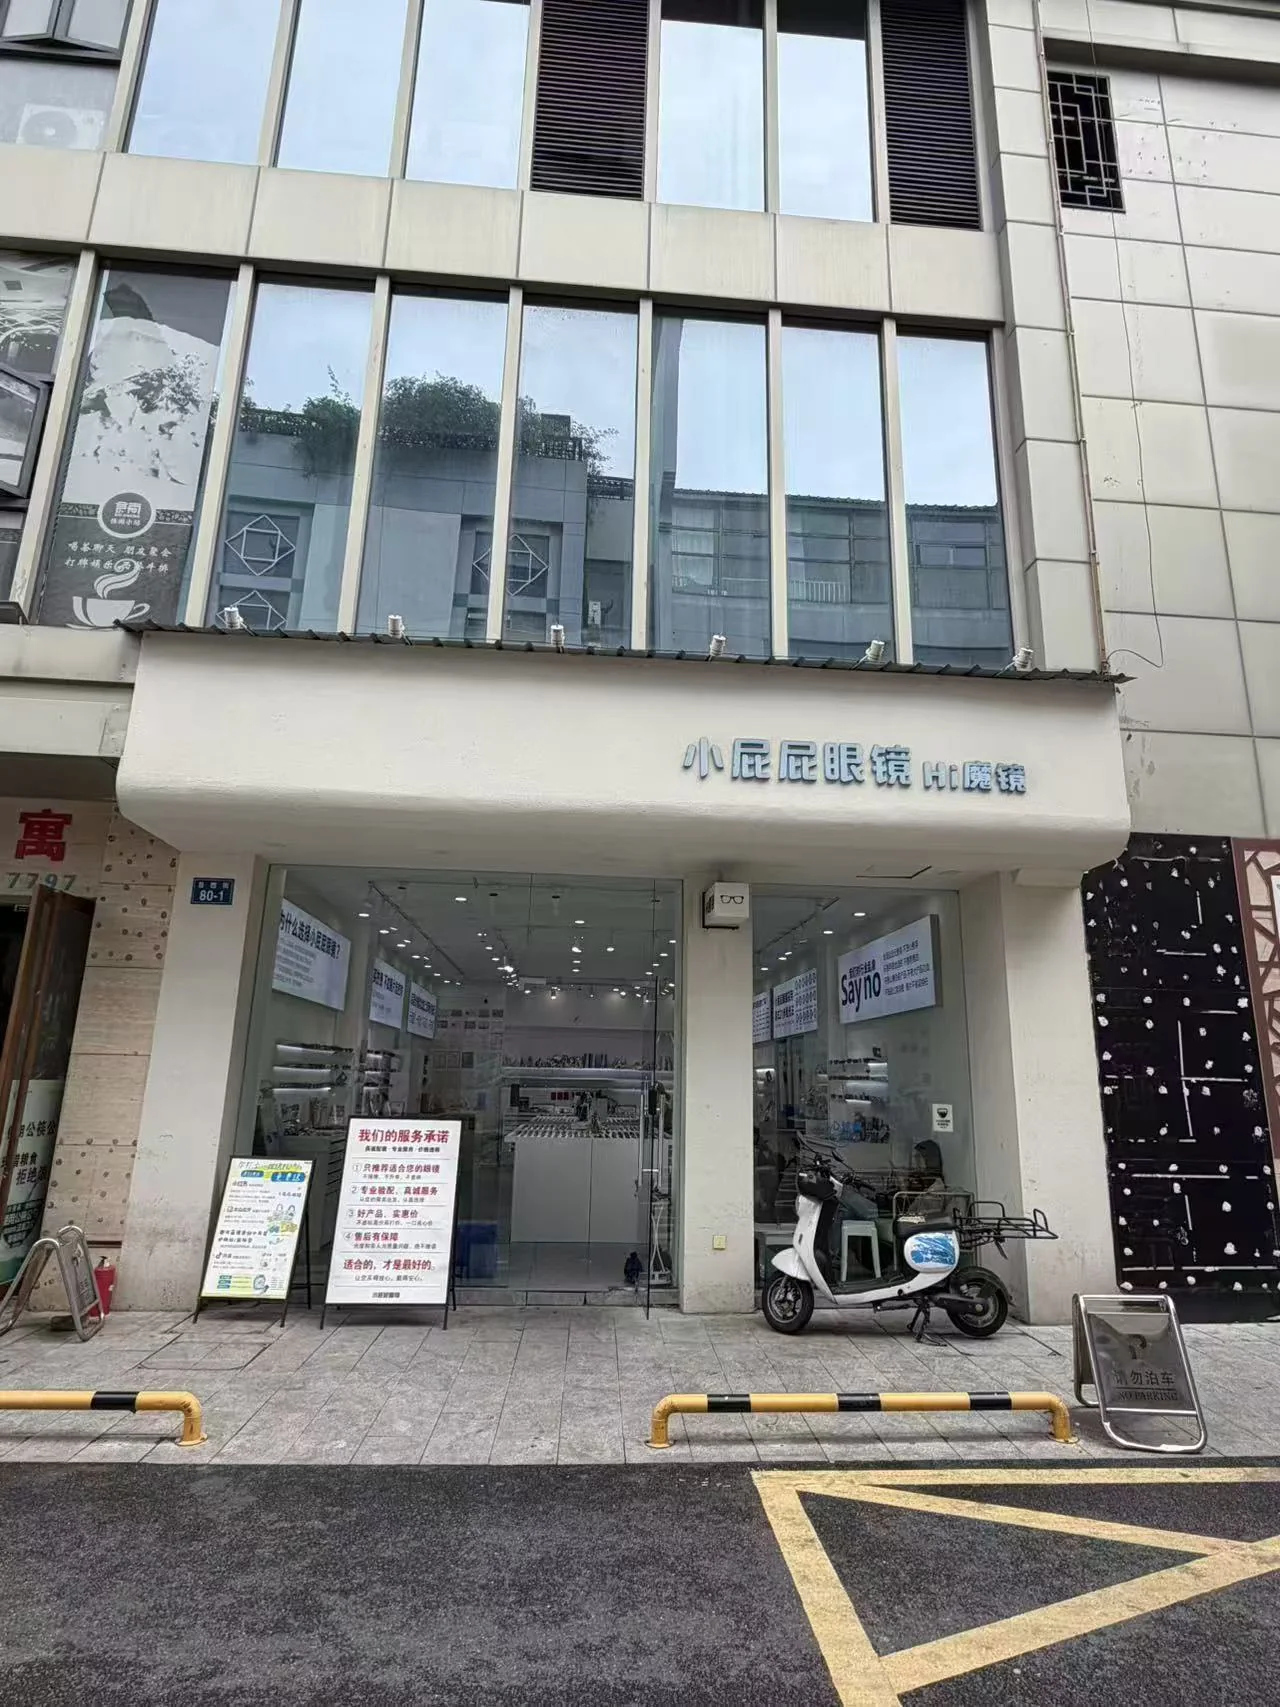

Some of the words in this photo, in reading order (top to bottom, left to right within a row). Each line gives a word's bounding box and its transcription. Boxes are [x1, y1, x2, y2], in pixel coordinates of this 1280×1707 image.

[683, 737, 912, 787] 小屁屁眼镜
[15, 808, 72, 861] 寓
[200, 889, 224, 901] 80-1
[841, 974, 861, 1012] Say
[864, 971, 881, 1000] no
[358, 1128, 450, 1143] 我们的服务承诺
[362, 1164, 440, 1174] 只推荐适合您的眼镜
[354, 1232, 399, 1241] 售后有保障
[1111, 1368, 1175, 1386] 请勿泊车
[1120, 1391, 1133, 1401] NO
[1136, 1391, 1178, 1401] PARKING
